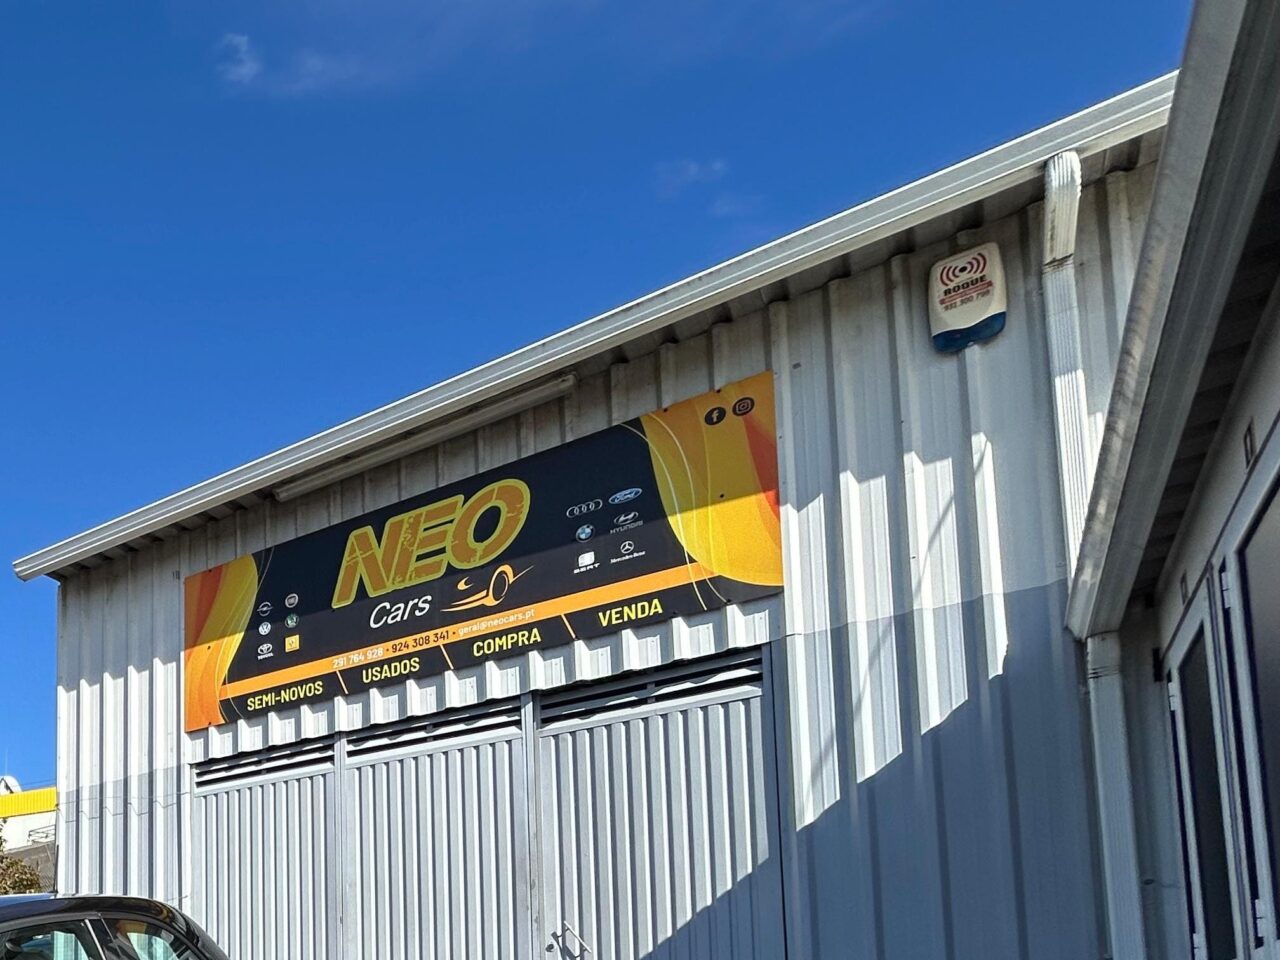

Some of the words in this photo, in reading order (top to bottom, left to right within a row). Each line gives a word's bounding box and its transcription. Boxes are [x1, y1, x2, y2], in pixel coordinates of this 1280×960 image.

[943, 274, 987, 297] ROQUE
[331, 478, 531, 609] NEO
[370, 595, 433, 629] Cars
[598, 598, 663, 627] VENDA
[332, 656, 347, 669] 291
[349, 652, 365, 665] 764
[367, 647, 384, 660] 928
[392, 640, 409, 653] 924
[412, 635, 431, 648] 308
[433, 630, 450, 643] 341
[458, 609, 536, 637] geral@neocars.pt
[473, 627, 542, 657] COMPRA
[362, 657, 420, 684] USADOS
[247, 681, 323, 711] SEMI-NOVOS
